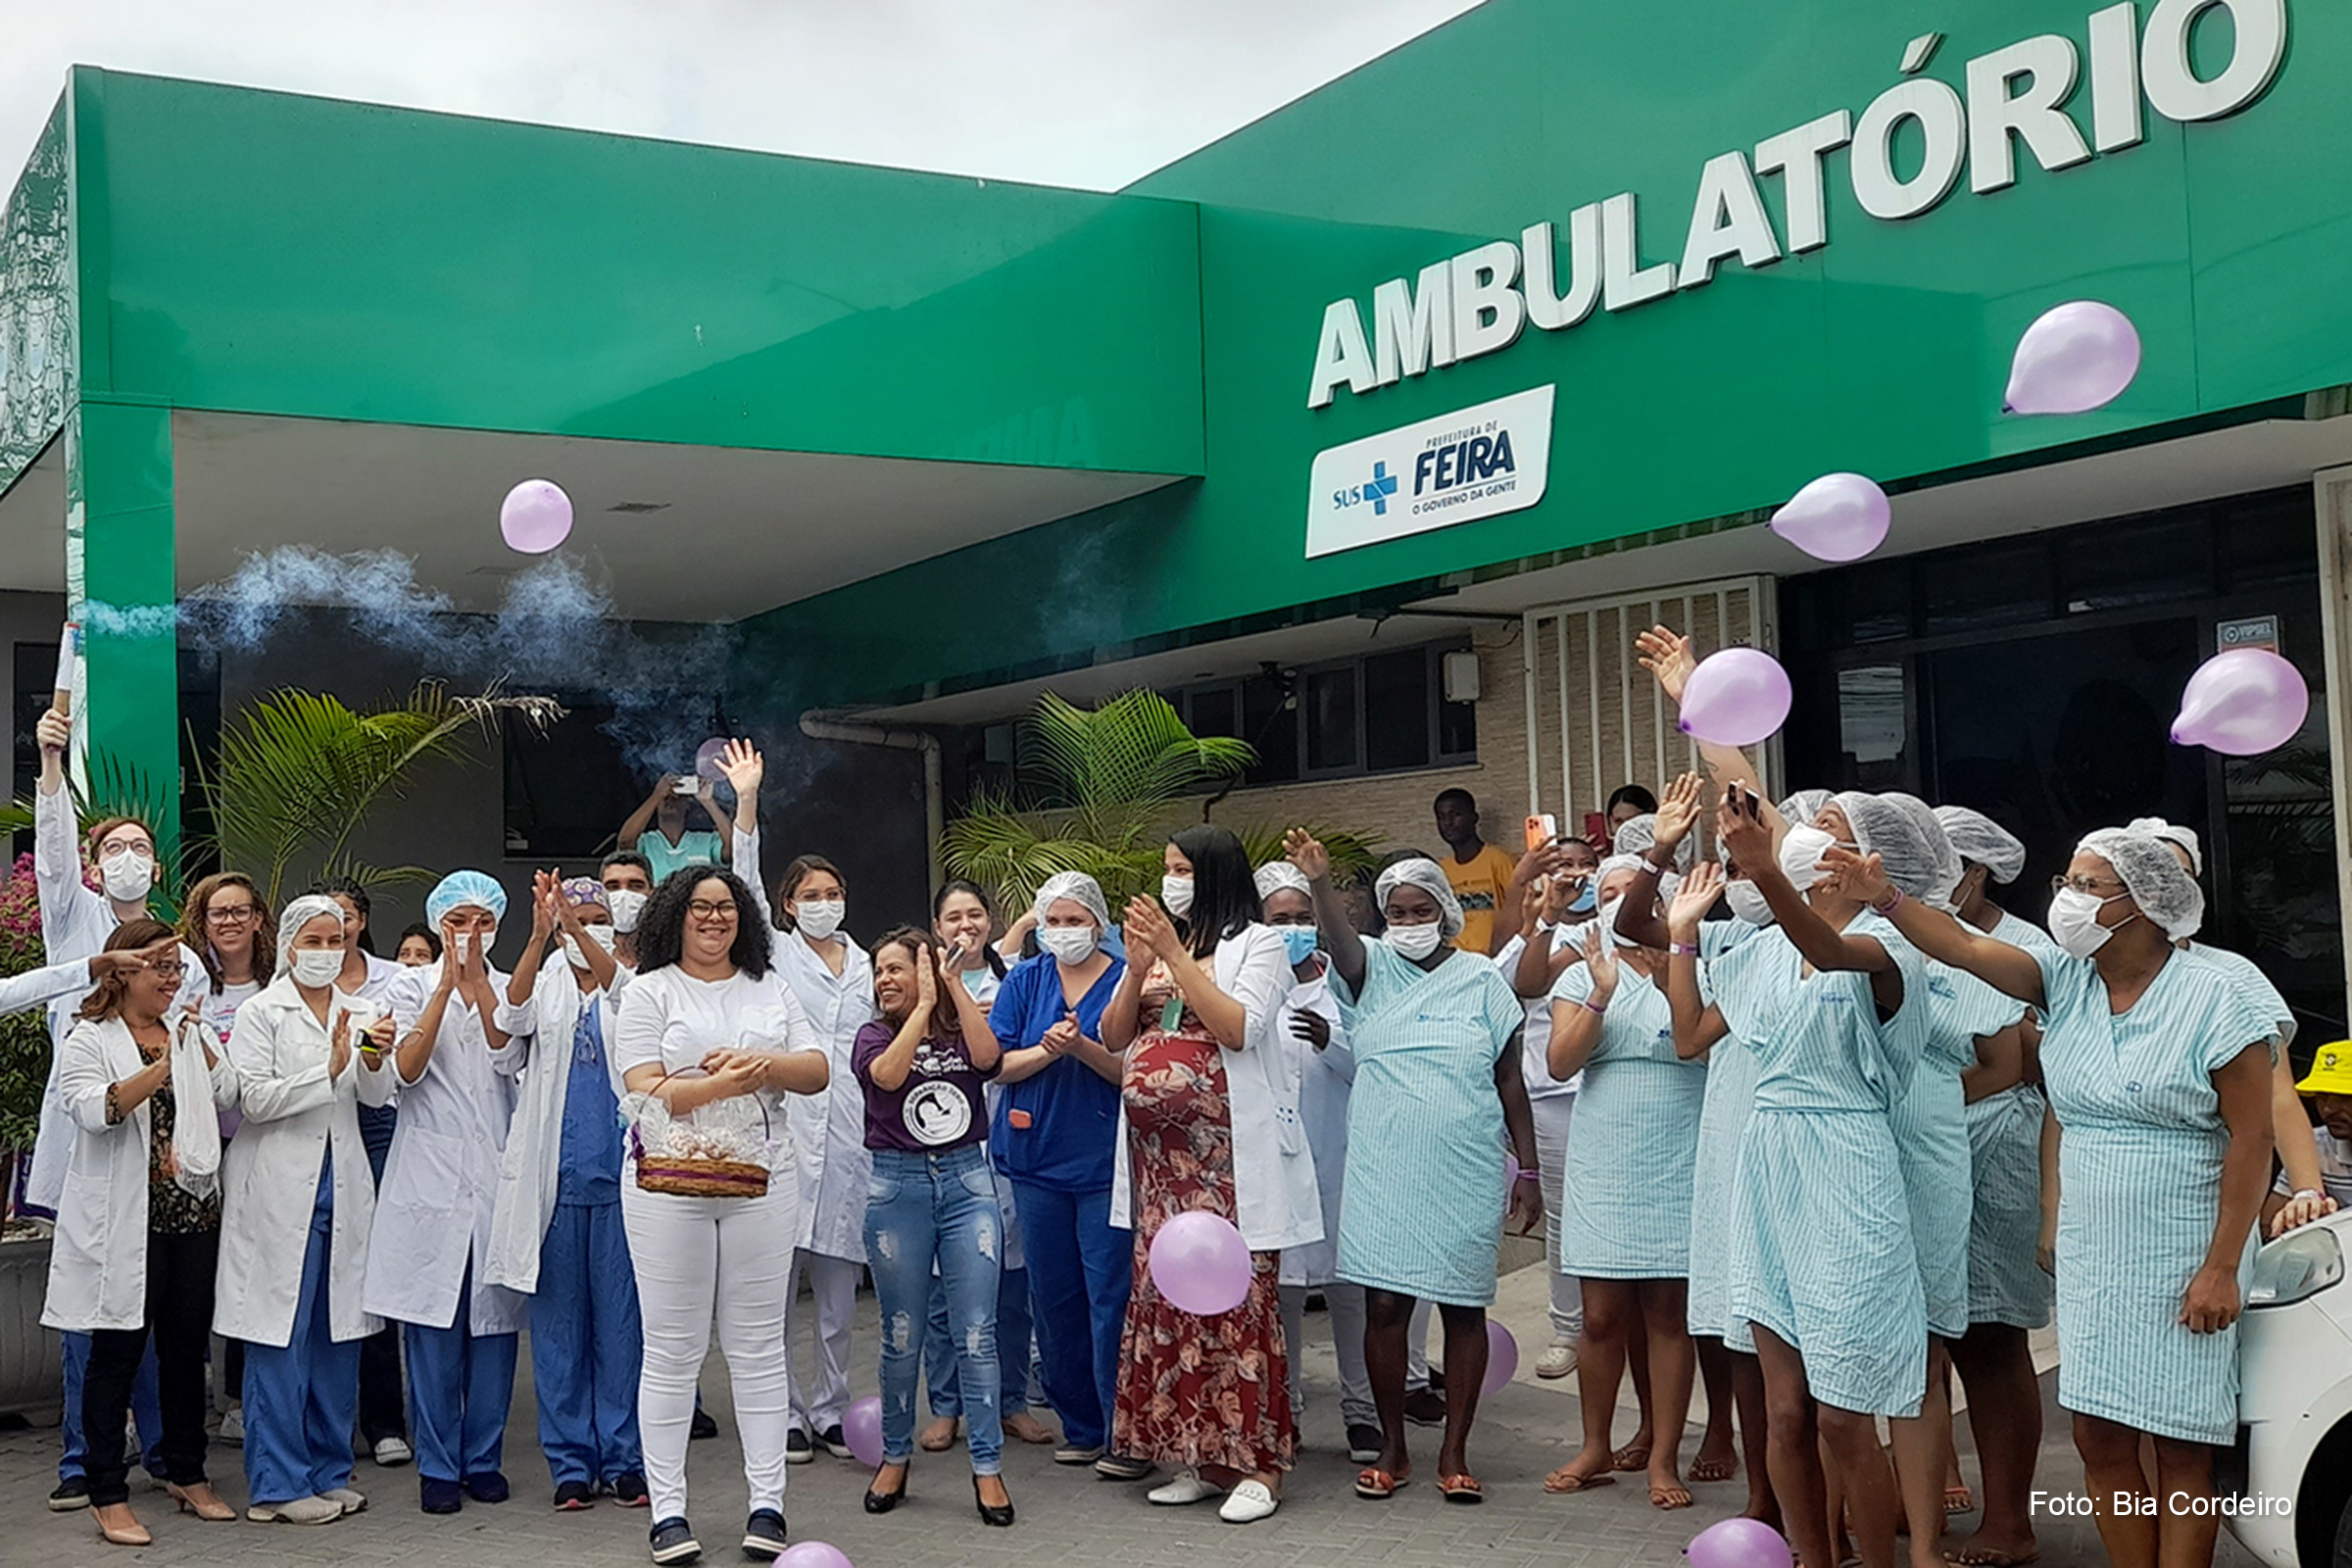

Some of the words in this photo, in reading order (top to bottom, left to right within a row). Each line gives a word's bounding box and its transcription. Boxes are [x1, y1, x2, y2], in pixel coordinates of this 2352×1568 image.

[1306, 0, 2287, 411] AMBULATÓRIO
[1427, 425, 1481, 448] PREFEITURA
[1485, 420, 1497, 433] DE
[1414, 429, 1516, 496] FEIRA
[1333, 486, 1361, 510] SUS
[1412, 504, 1420, 514] O
[1422, 492, 1468, 512] GOVERNO
[1470, 489, 1483, 501] DA
[1486, 480, 1517, 497] GENTE
